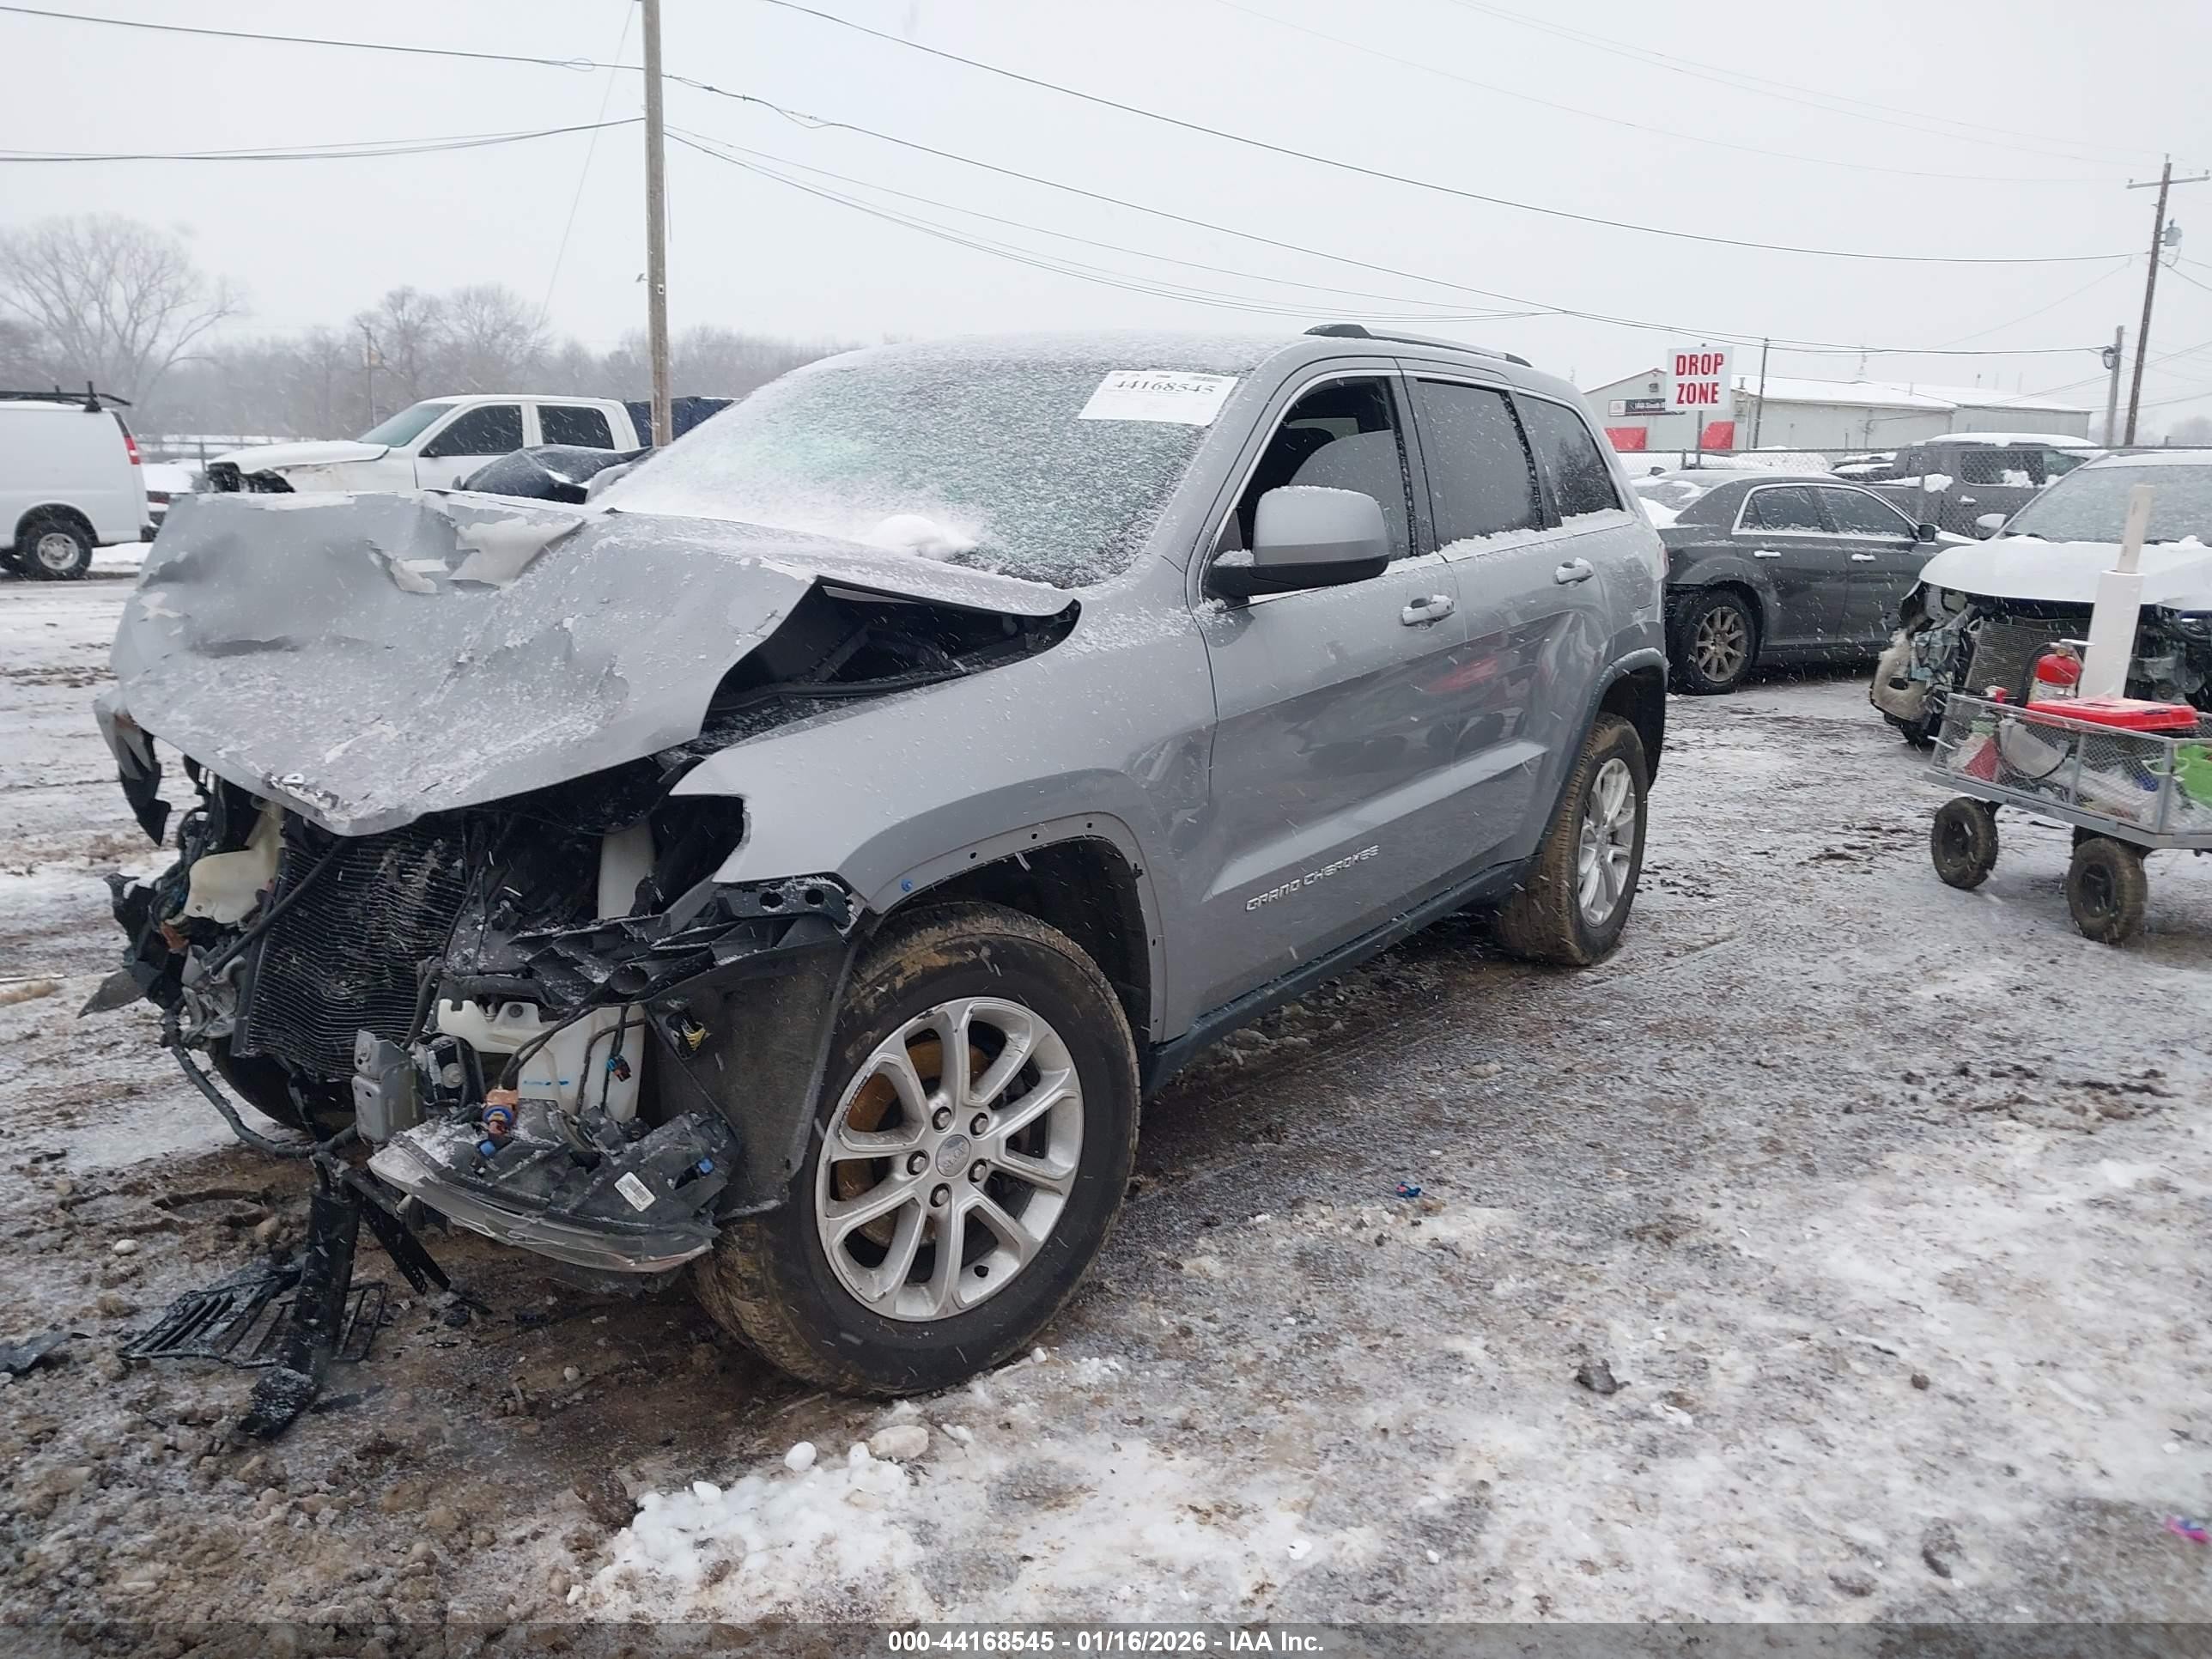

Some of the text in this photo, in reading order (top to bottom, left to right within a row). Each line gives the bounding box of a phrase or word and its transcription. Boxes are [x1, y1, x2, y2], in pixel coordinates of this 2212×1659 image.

[1675, 353, 1724, 376] DROP
[1114, 380, 1217, 394] 44168545
[1676, 382, 1720, 404] ZONE
[1246, 844, 1380, 911] GRAND CHEROKEE
